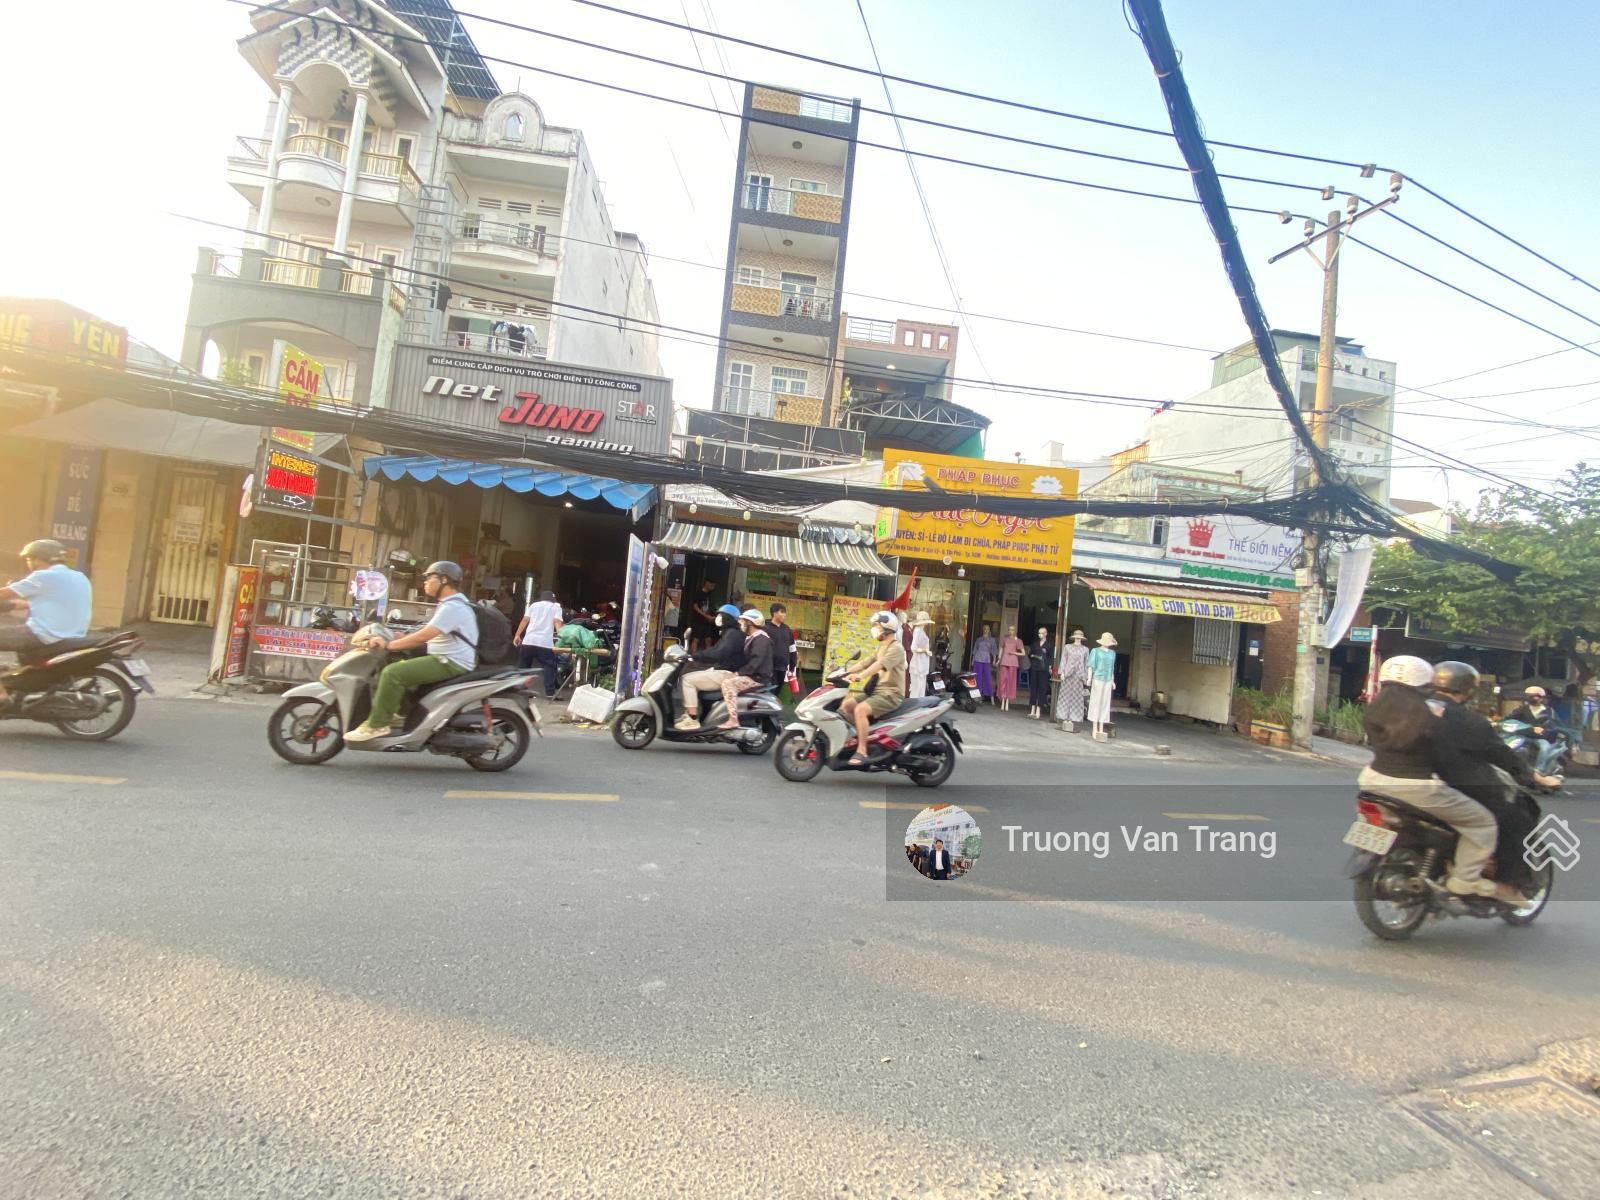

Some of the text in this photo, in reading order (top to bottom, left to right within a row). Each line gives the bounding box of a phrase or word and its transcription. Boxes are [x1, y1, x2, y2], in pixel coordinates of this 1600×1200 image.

[454, 360, 476, 369] CUNG
[477, 361, 493, 371] CẤP
[494, 365, 513, 373] DỊCH
[526, 368, 543, 377] TRÒ
[543, 371, 562, 380] CHƠI
[563, 374, 582, 382] ĐIỆN
[595, 379, 615, 388] CÔNG
[616, 381, 637, 391] CỘNG
[1229, 535, 1247, 553] THẾ
[1249, 540, 1269, 556] GIỚI
[1097, 593, 1123, 609] CƠM
[1126, 596, 1153, 611] TRƯA
[1163, 599, 1186, 614] CƠM
